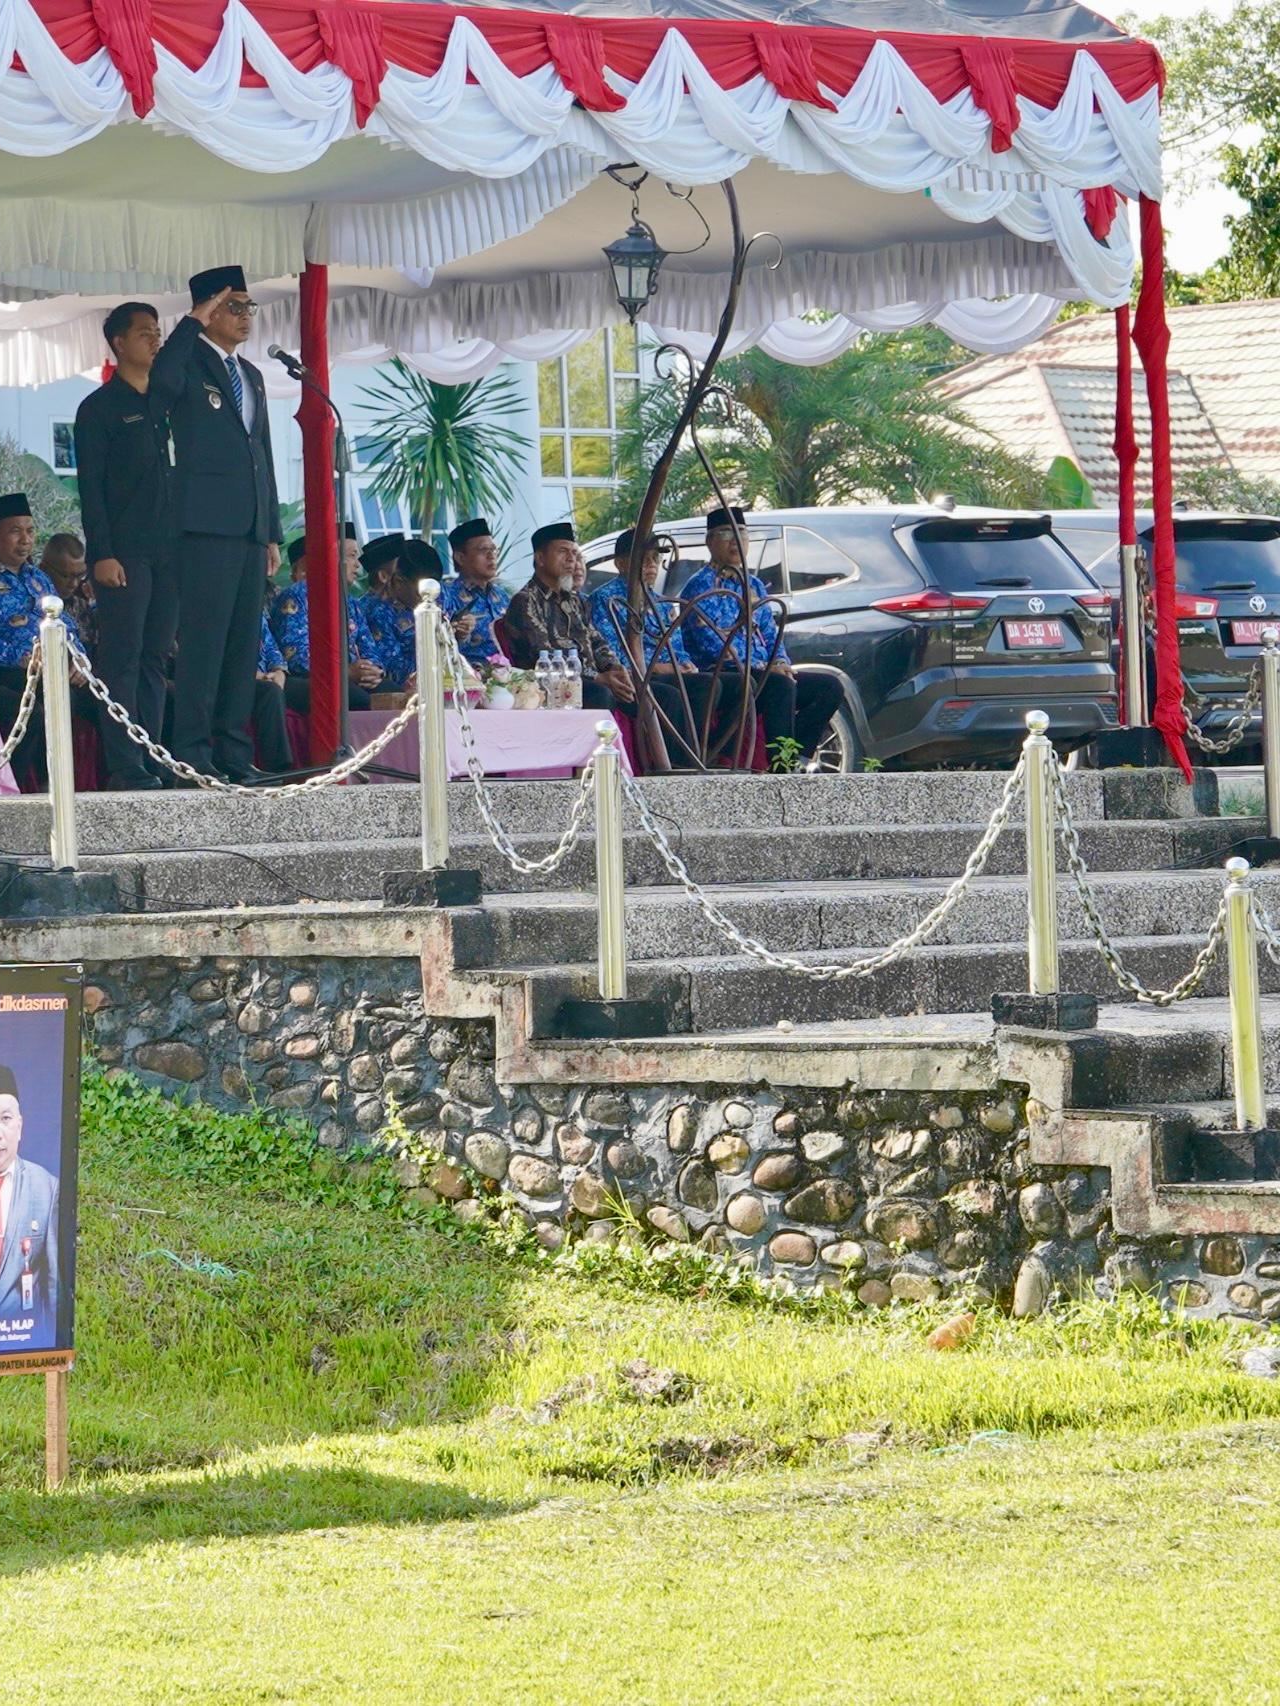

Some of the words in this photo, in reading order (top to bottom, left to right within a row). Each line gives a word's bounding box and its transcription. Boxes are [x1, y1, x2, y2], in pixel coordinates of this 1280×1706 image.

[1007, 623, 1021, 638] DA
[1022, 623, 1045, 638] 1430
[1047, 623, 1061, 637] YH
[26, 1356, 67, 1369] BALANGAN
